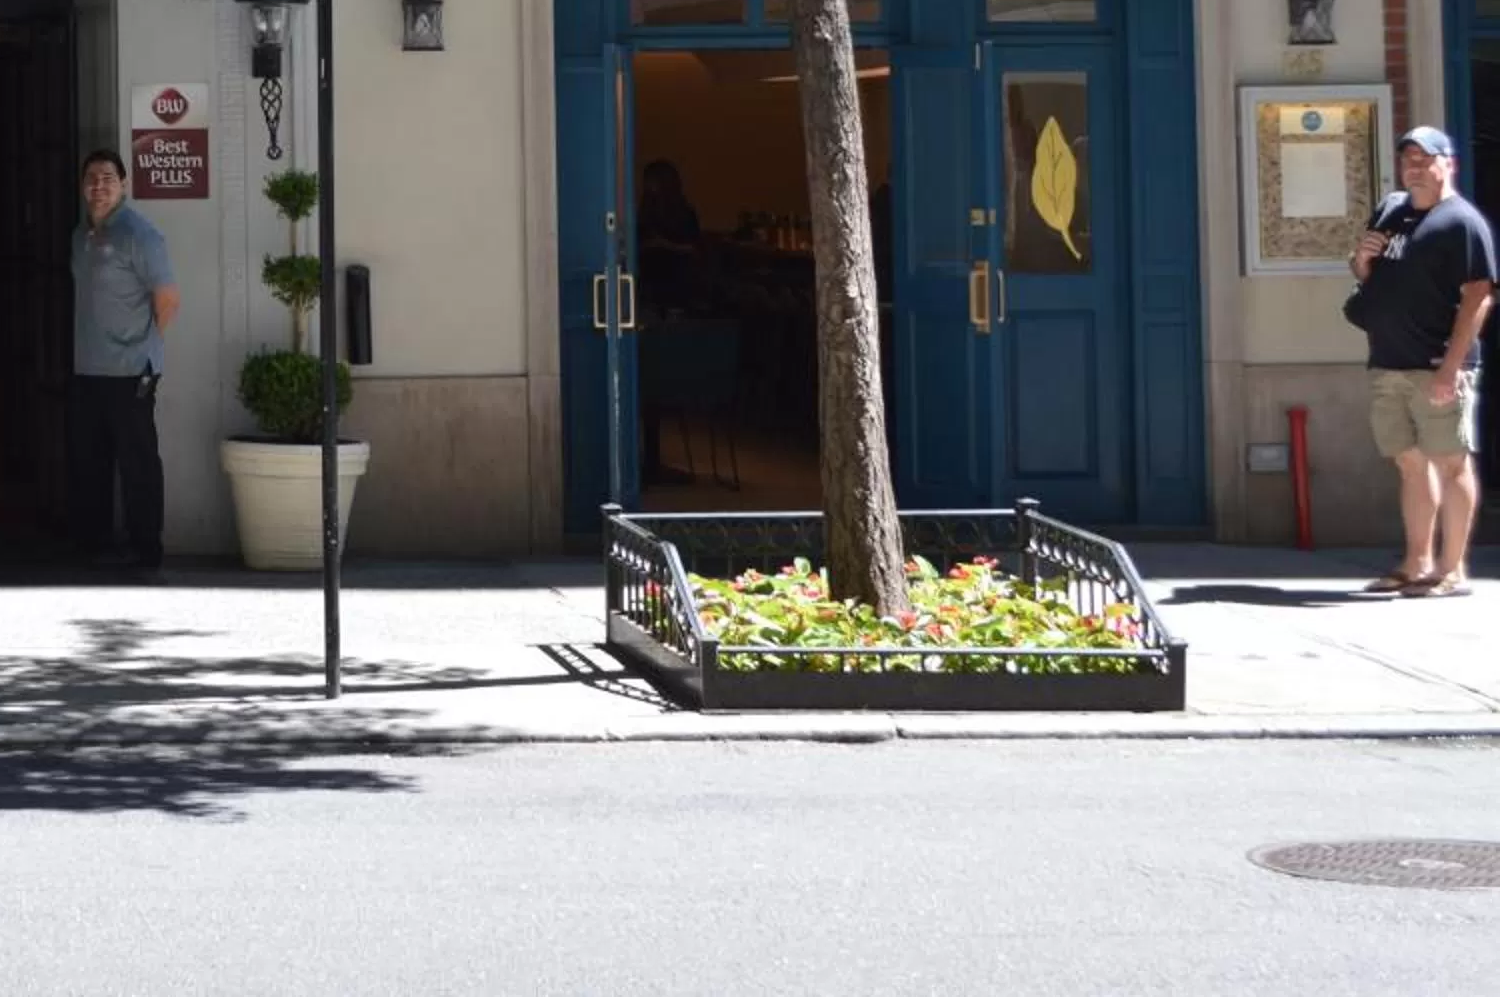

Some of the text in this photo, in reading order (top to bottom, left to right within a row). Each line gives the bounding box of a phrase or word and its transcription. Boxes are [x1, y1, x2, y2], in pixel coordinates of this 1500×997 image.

[155, 98, 184, 115] BW
[153, 139, 188, 154] Best
[138, 154, 203, 168] Western
[151, 170, 193, 184] PLUS
